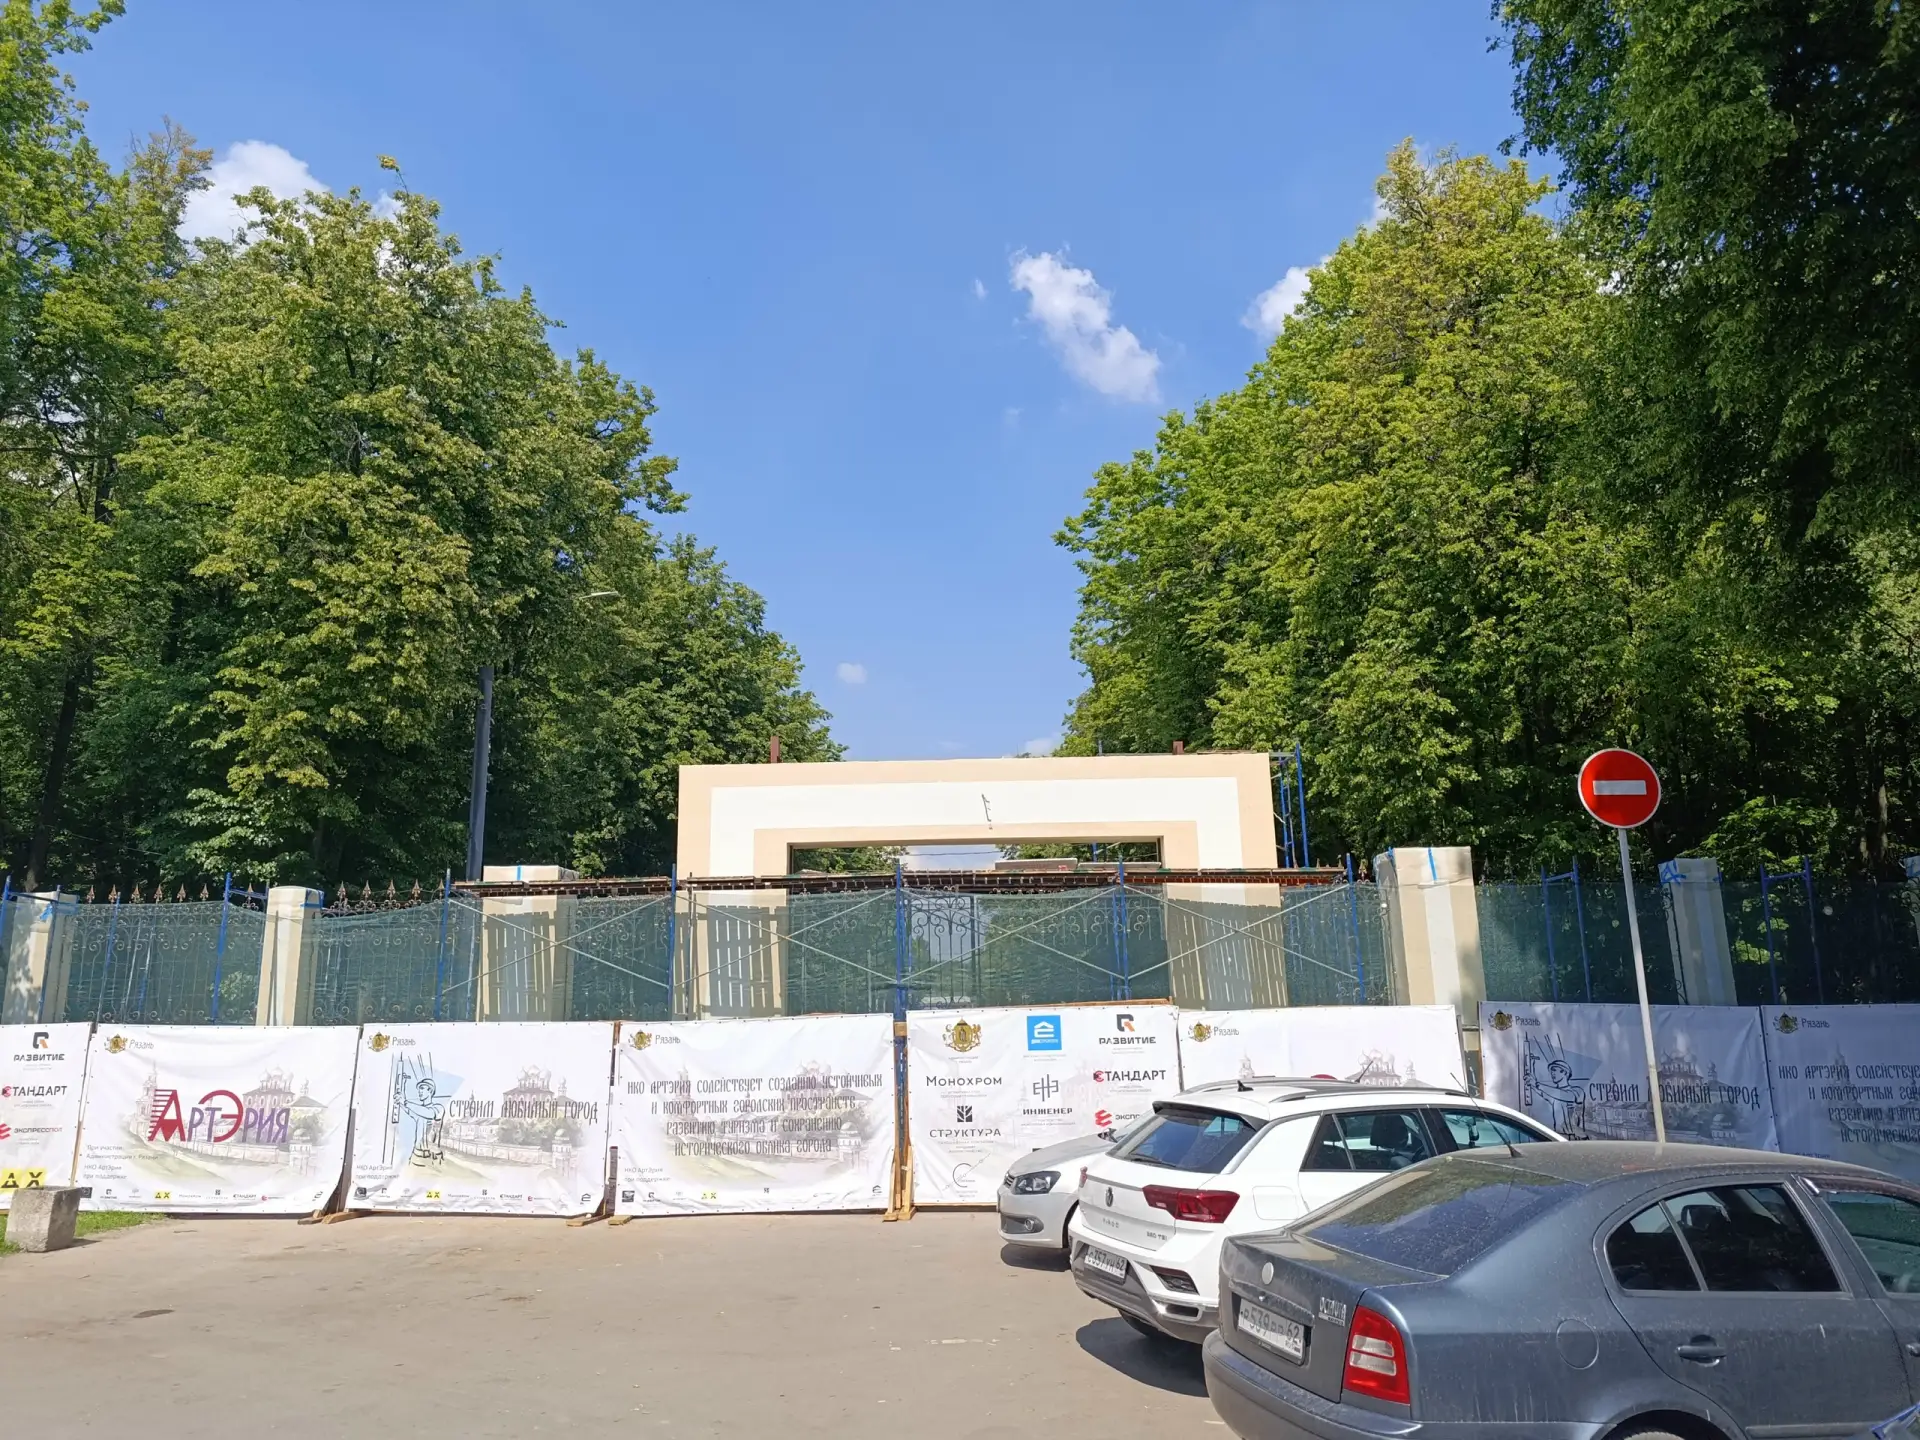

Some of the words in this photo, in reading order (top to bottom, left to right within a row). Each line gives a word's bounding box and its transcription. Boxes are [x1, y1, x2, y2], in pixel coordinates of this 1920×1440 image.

[1515, 1016, 1541, 1026] Рязань
[1801, 1018, 1830, 1028] Рязань
[1213, 1026, 1239, 1036] Рязань
[392, 1036, 416, 1046] Рязань
[655, 1035, 681, 1044] Рязань
[1099, 1037, 1156, 1045] РАЗВИТИЕ
[14, 1053, 65, 1062] РАЗВИТИЕ
[1093, 1070, 1166, 1083] СТАНДАРТ
[2, 1086, 67, 1097] СТАНДАРТ
[1022, 1107, 1073, 1115] ИНЖЕНЕР
[929, 1128, 1002, 1138] СТРУКТУРА
